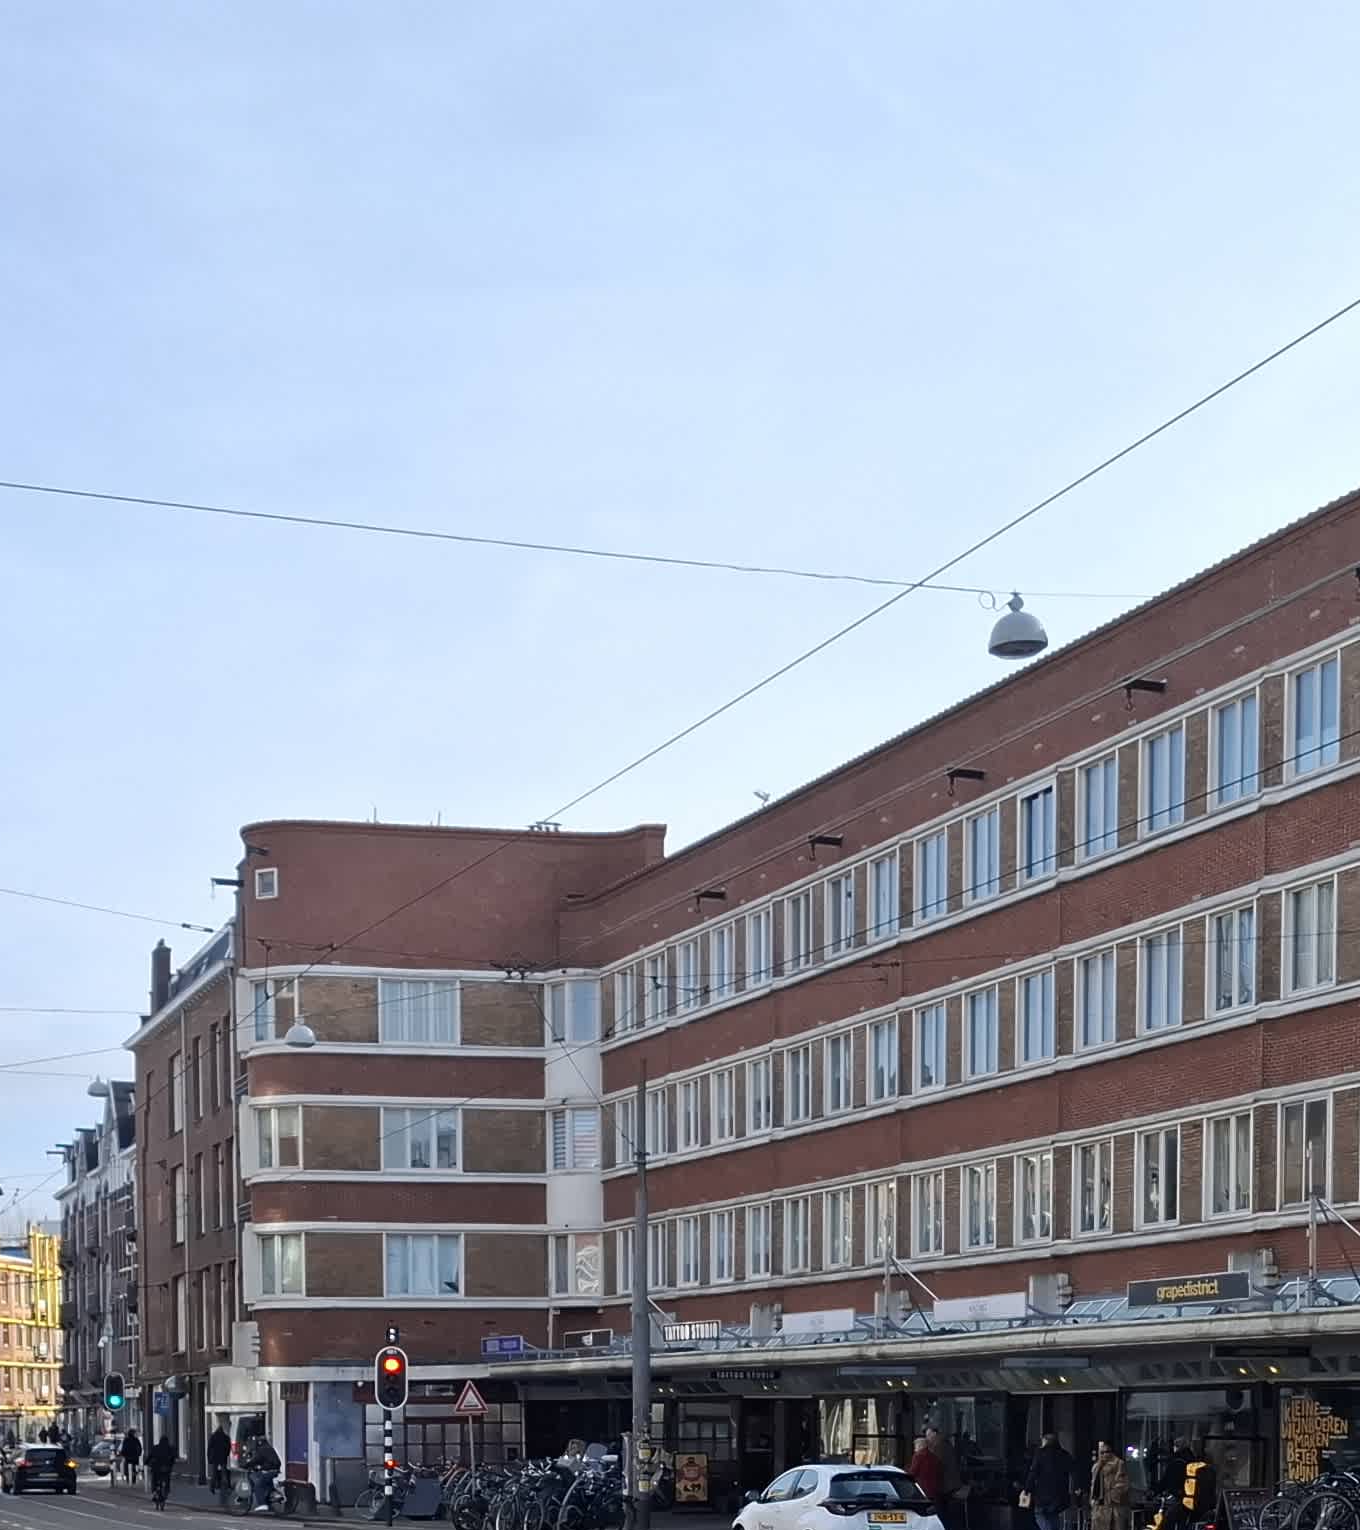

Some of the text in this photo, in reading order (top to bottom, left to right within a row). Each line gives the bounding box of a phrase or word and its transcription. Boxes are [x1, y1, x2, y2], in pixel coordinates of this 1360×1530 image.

[1156, 1279, 1219, 1302] grapedistrict
[665, 1322, 718, 1341] TATTOO STUDIO
[1287, 1441, 1318, 1465] BETER
